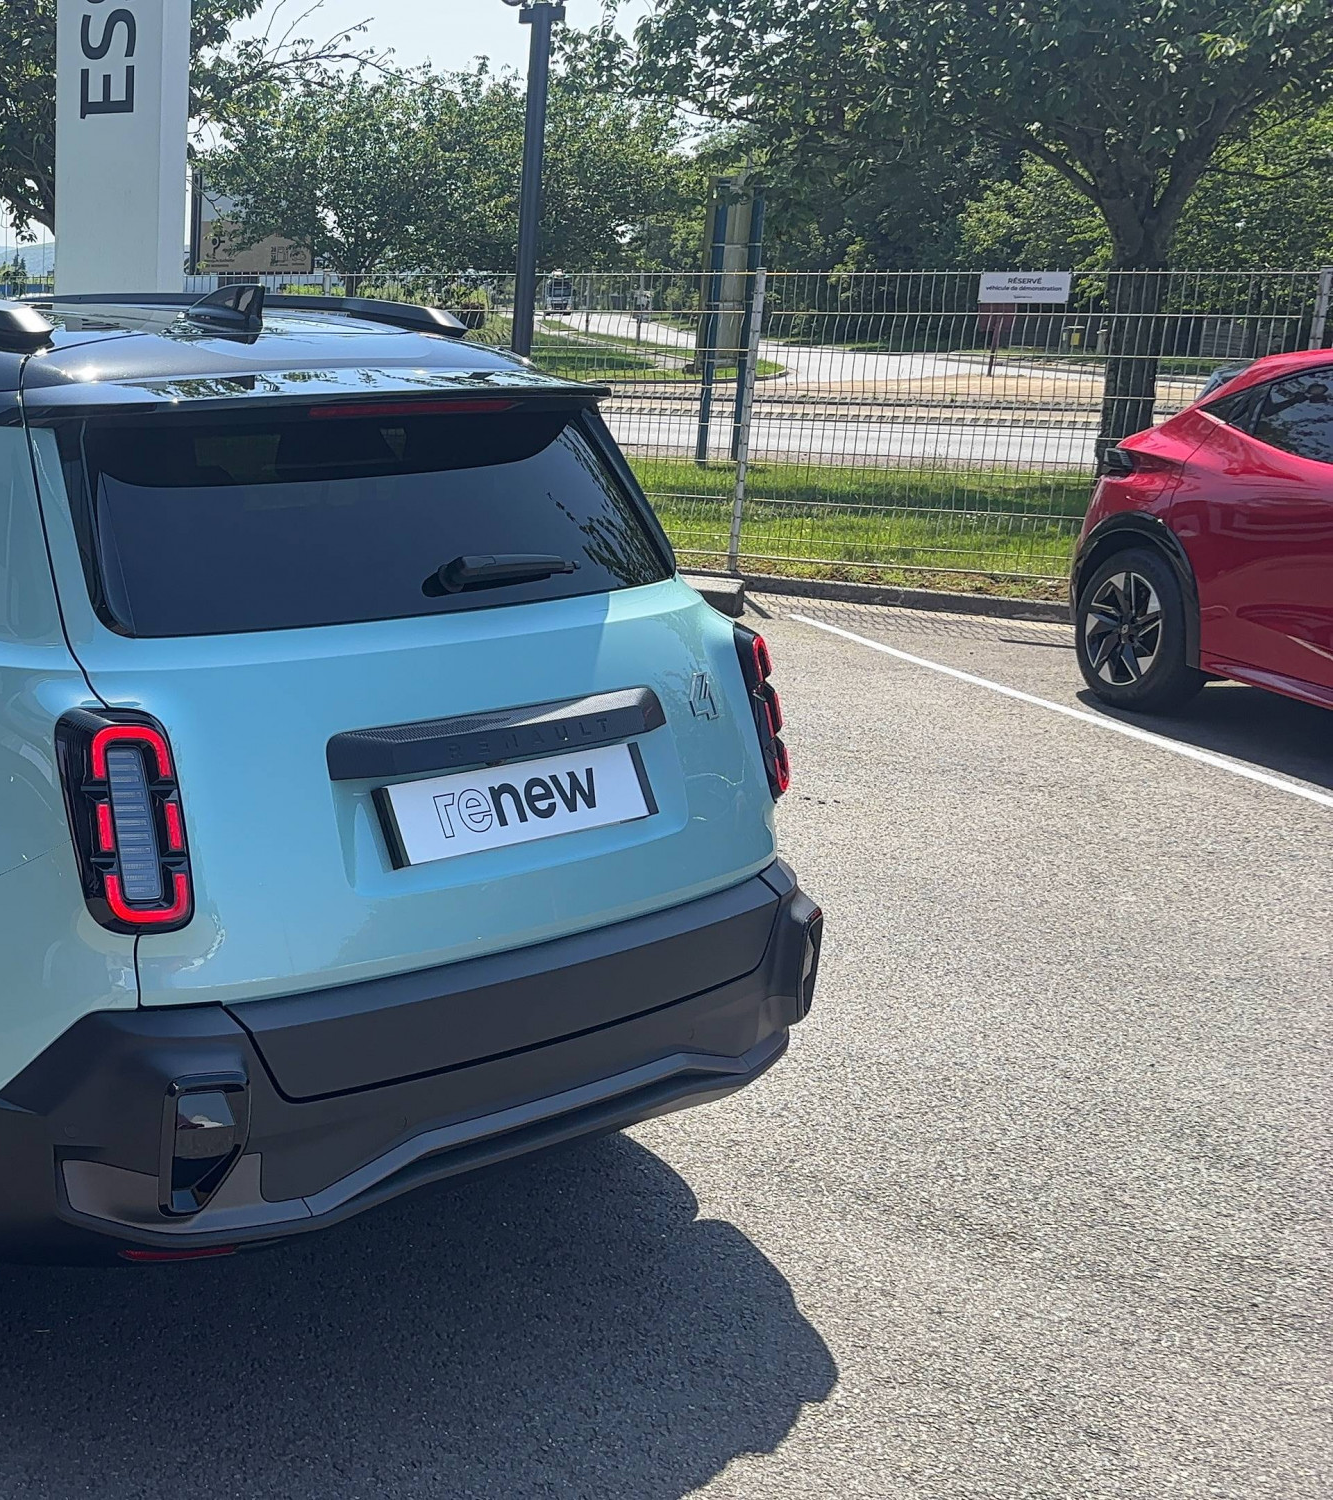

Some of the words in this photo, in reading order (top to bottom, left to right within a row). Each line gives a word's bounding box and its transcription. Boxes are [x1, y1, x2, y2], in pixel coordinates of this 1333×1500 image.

[80, 0, 137, 120] ES
[1007, 277, 1043, 285] RÉSERVÉ
[447, 716, 611, 761] RENAULT
[432, 767, 598, 839] renew
